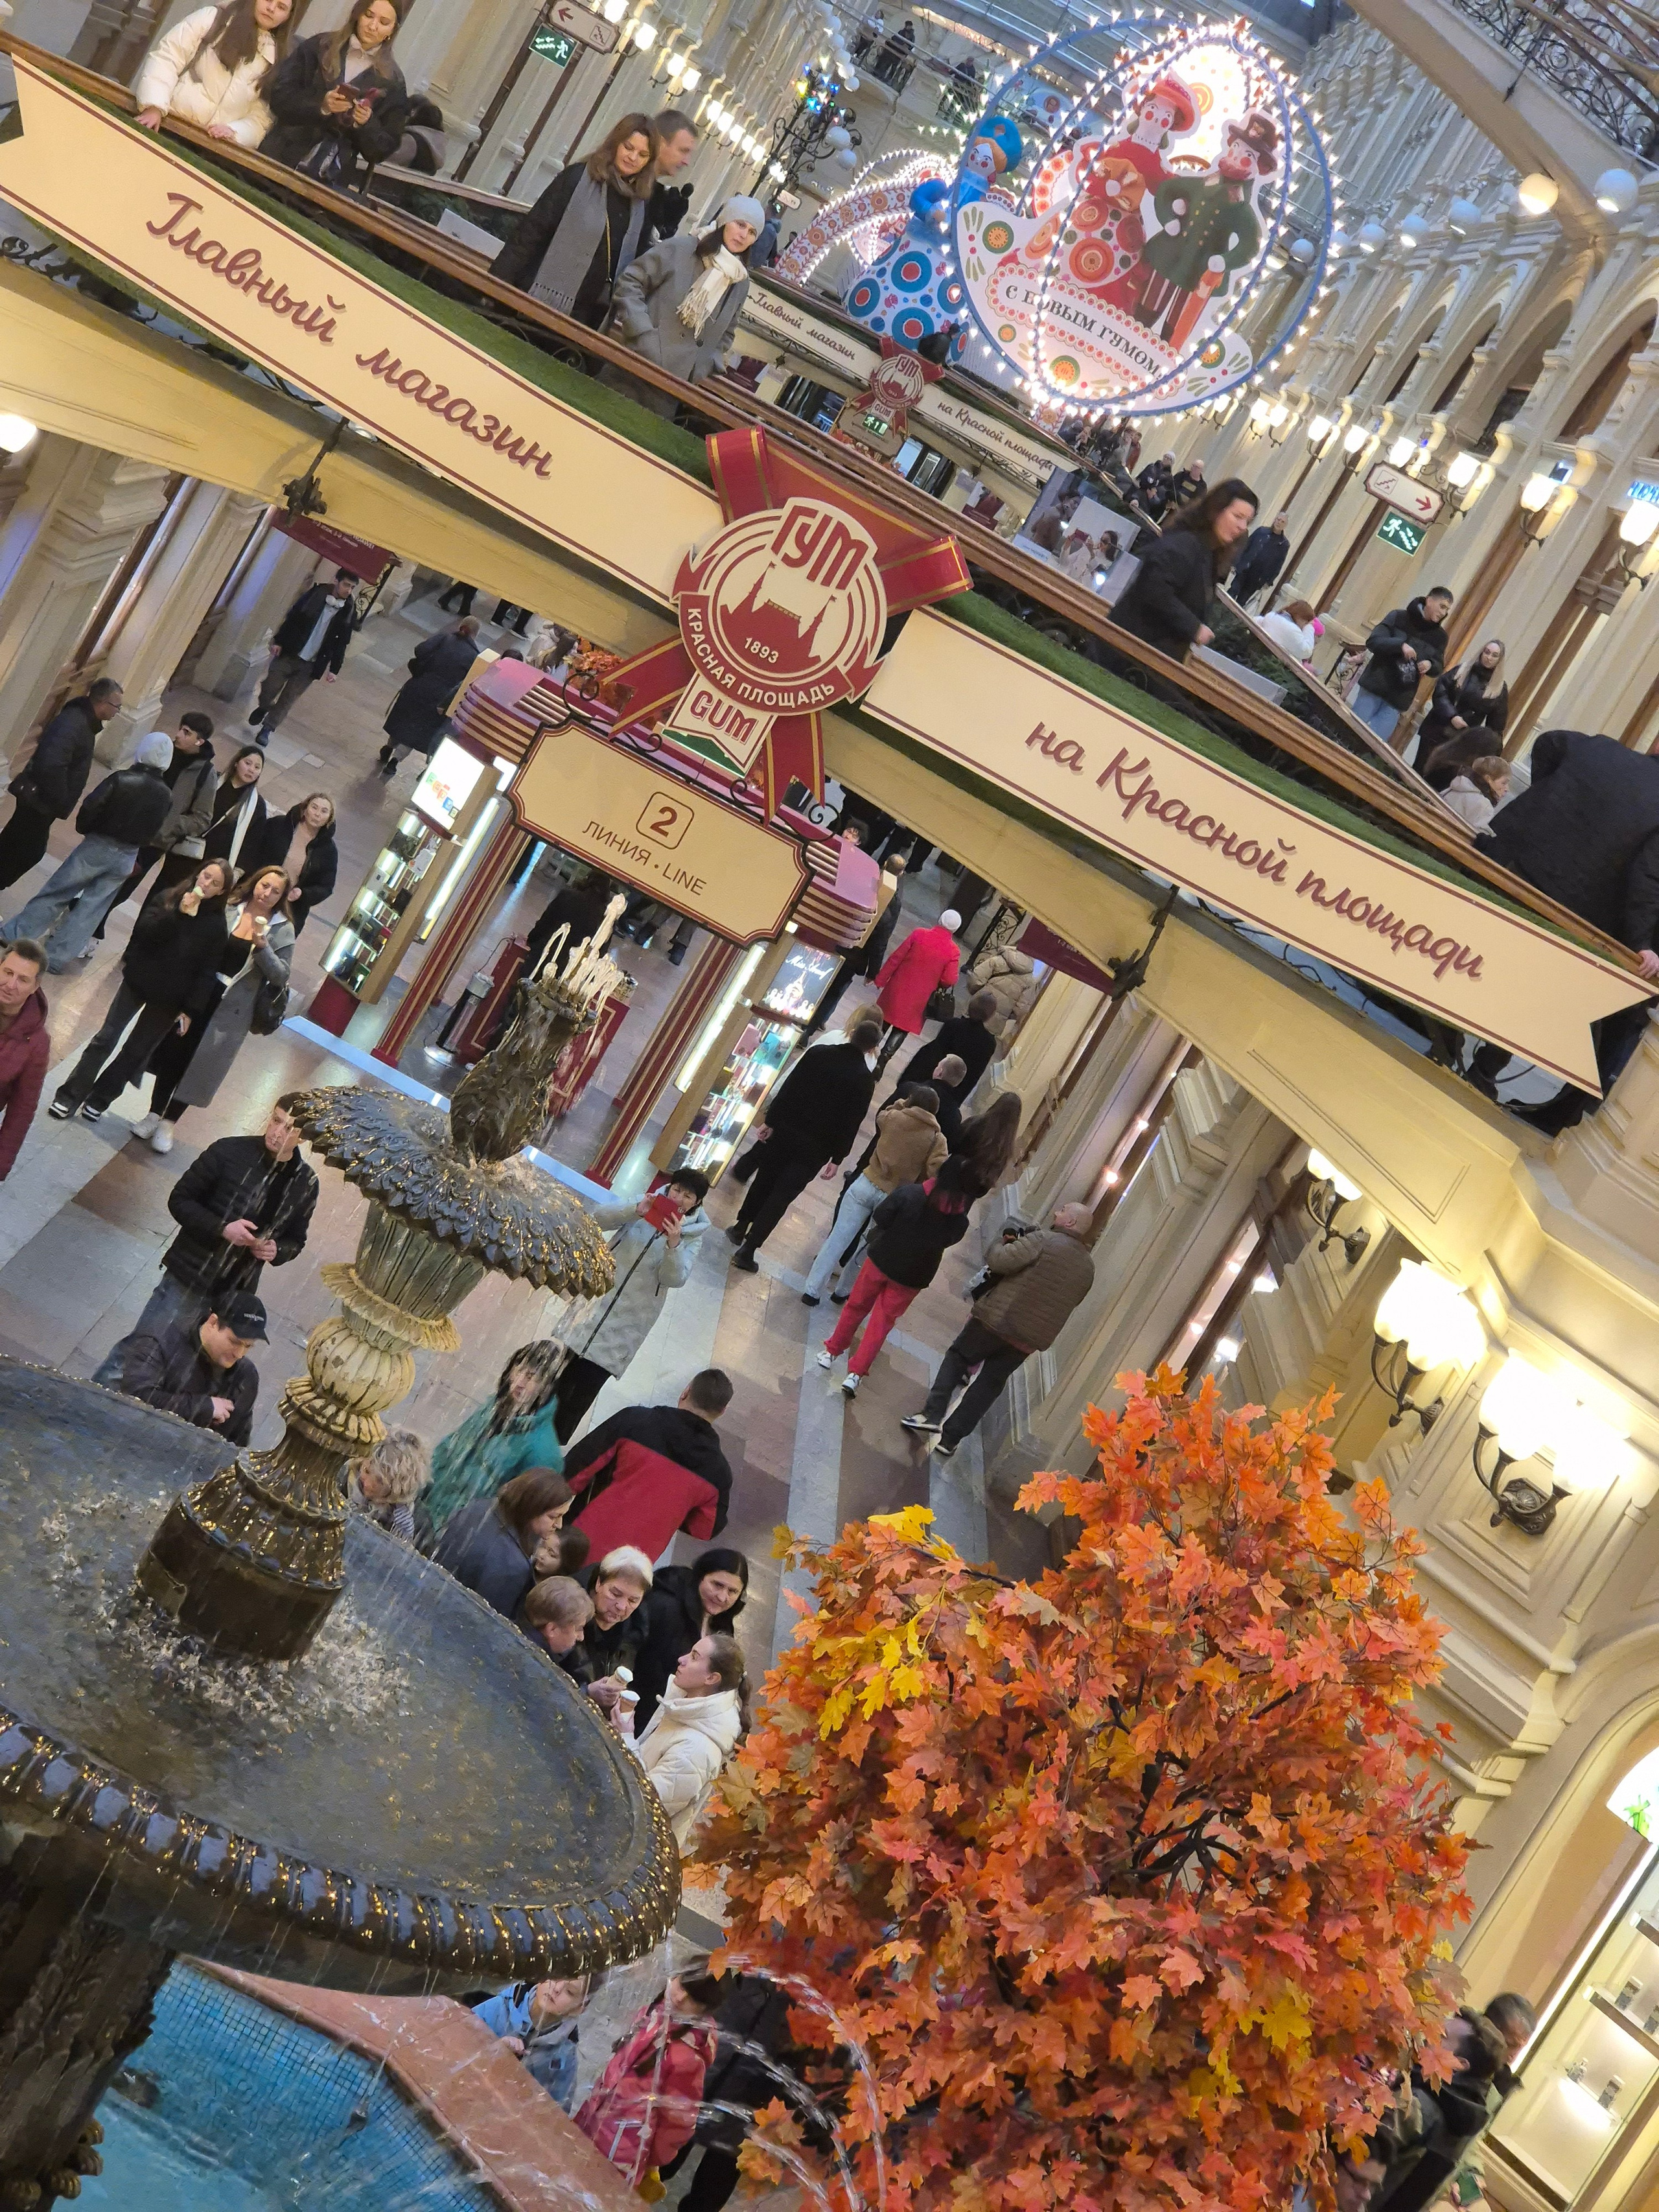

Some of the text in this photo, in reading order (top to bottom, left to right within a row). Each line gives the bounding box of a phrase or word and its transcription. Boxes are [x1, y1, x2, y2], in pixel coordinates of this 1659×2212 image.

[146, 192, 553, 477] Главный магазин
[753, 292, 856, 360] Главный магазин
[895, 356, 920, 378] ГУМ
[875, 403, 892, 418] GUM
[937, 401, 1053, 471] на Красной площади
[771, 505, 869, 590] ГУМ
[688, 608, 835, 708] КРАСНАЯ ПЛОЩАДЬ
[745, 636, 779, 664] 1893
[690, 690, 758, 743] GUM
[649, 806, 678, 837] 2
[1025, 721, 1483, 979] на Красной площади
[582, 821, 707, 896] ЛИНИЯ LINE
